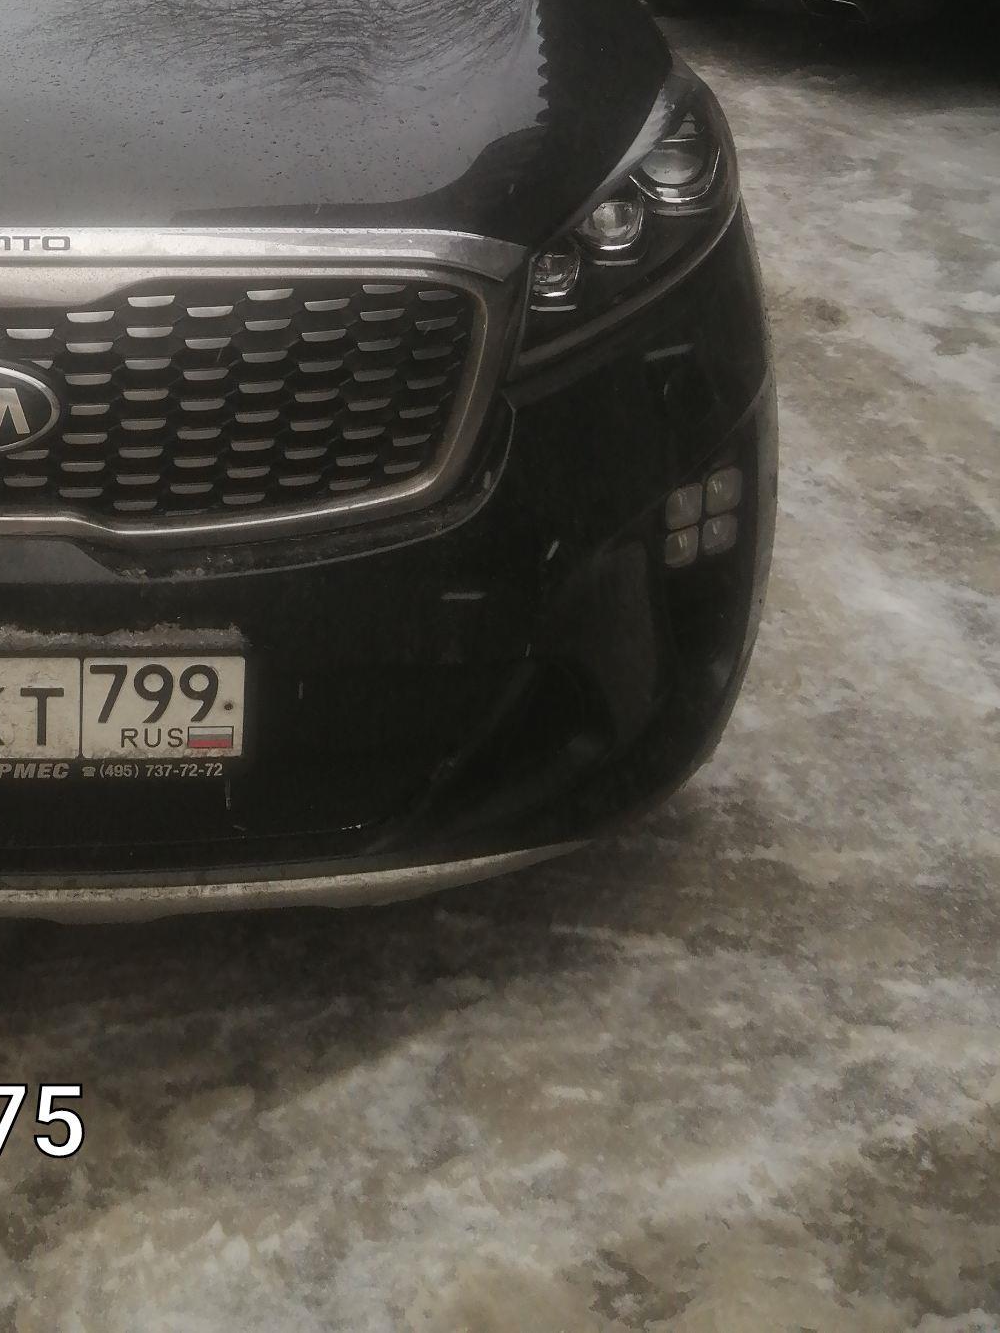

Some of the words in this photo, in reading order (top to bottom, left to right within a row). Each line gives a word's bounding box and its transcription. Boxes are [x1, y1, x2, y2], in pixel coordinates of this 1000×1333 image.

[89, 663, 221, 724] 799
[120, 727, 183, 748] RUS
[99, 763, 139, 779] (495)
[145, 763, 223, 778] 737-72-72
